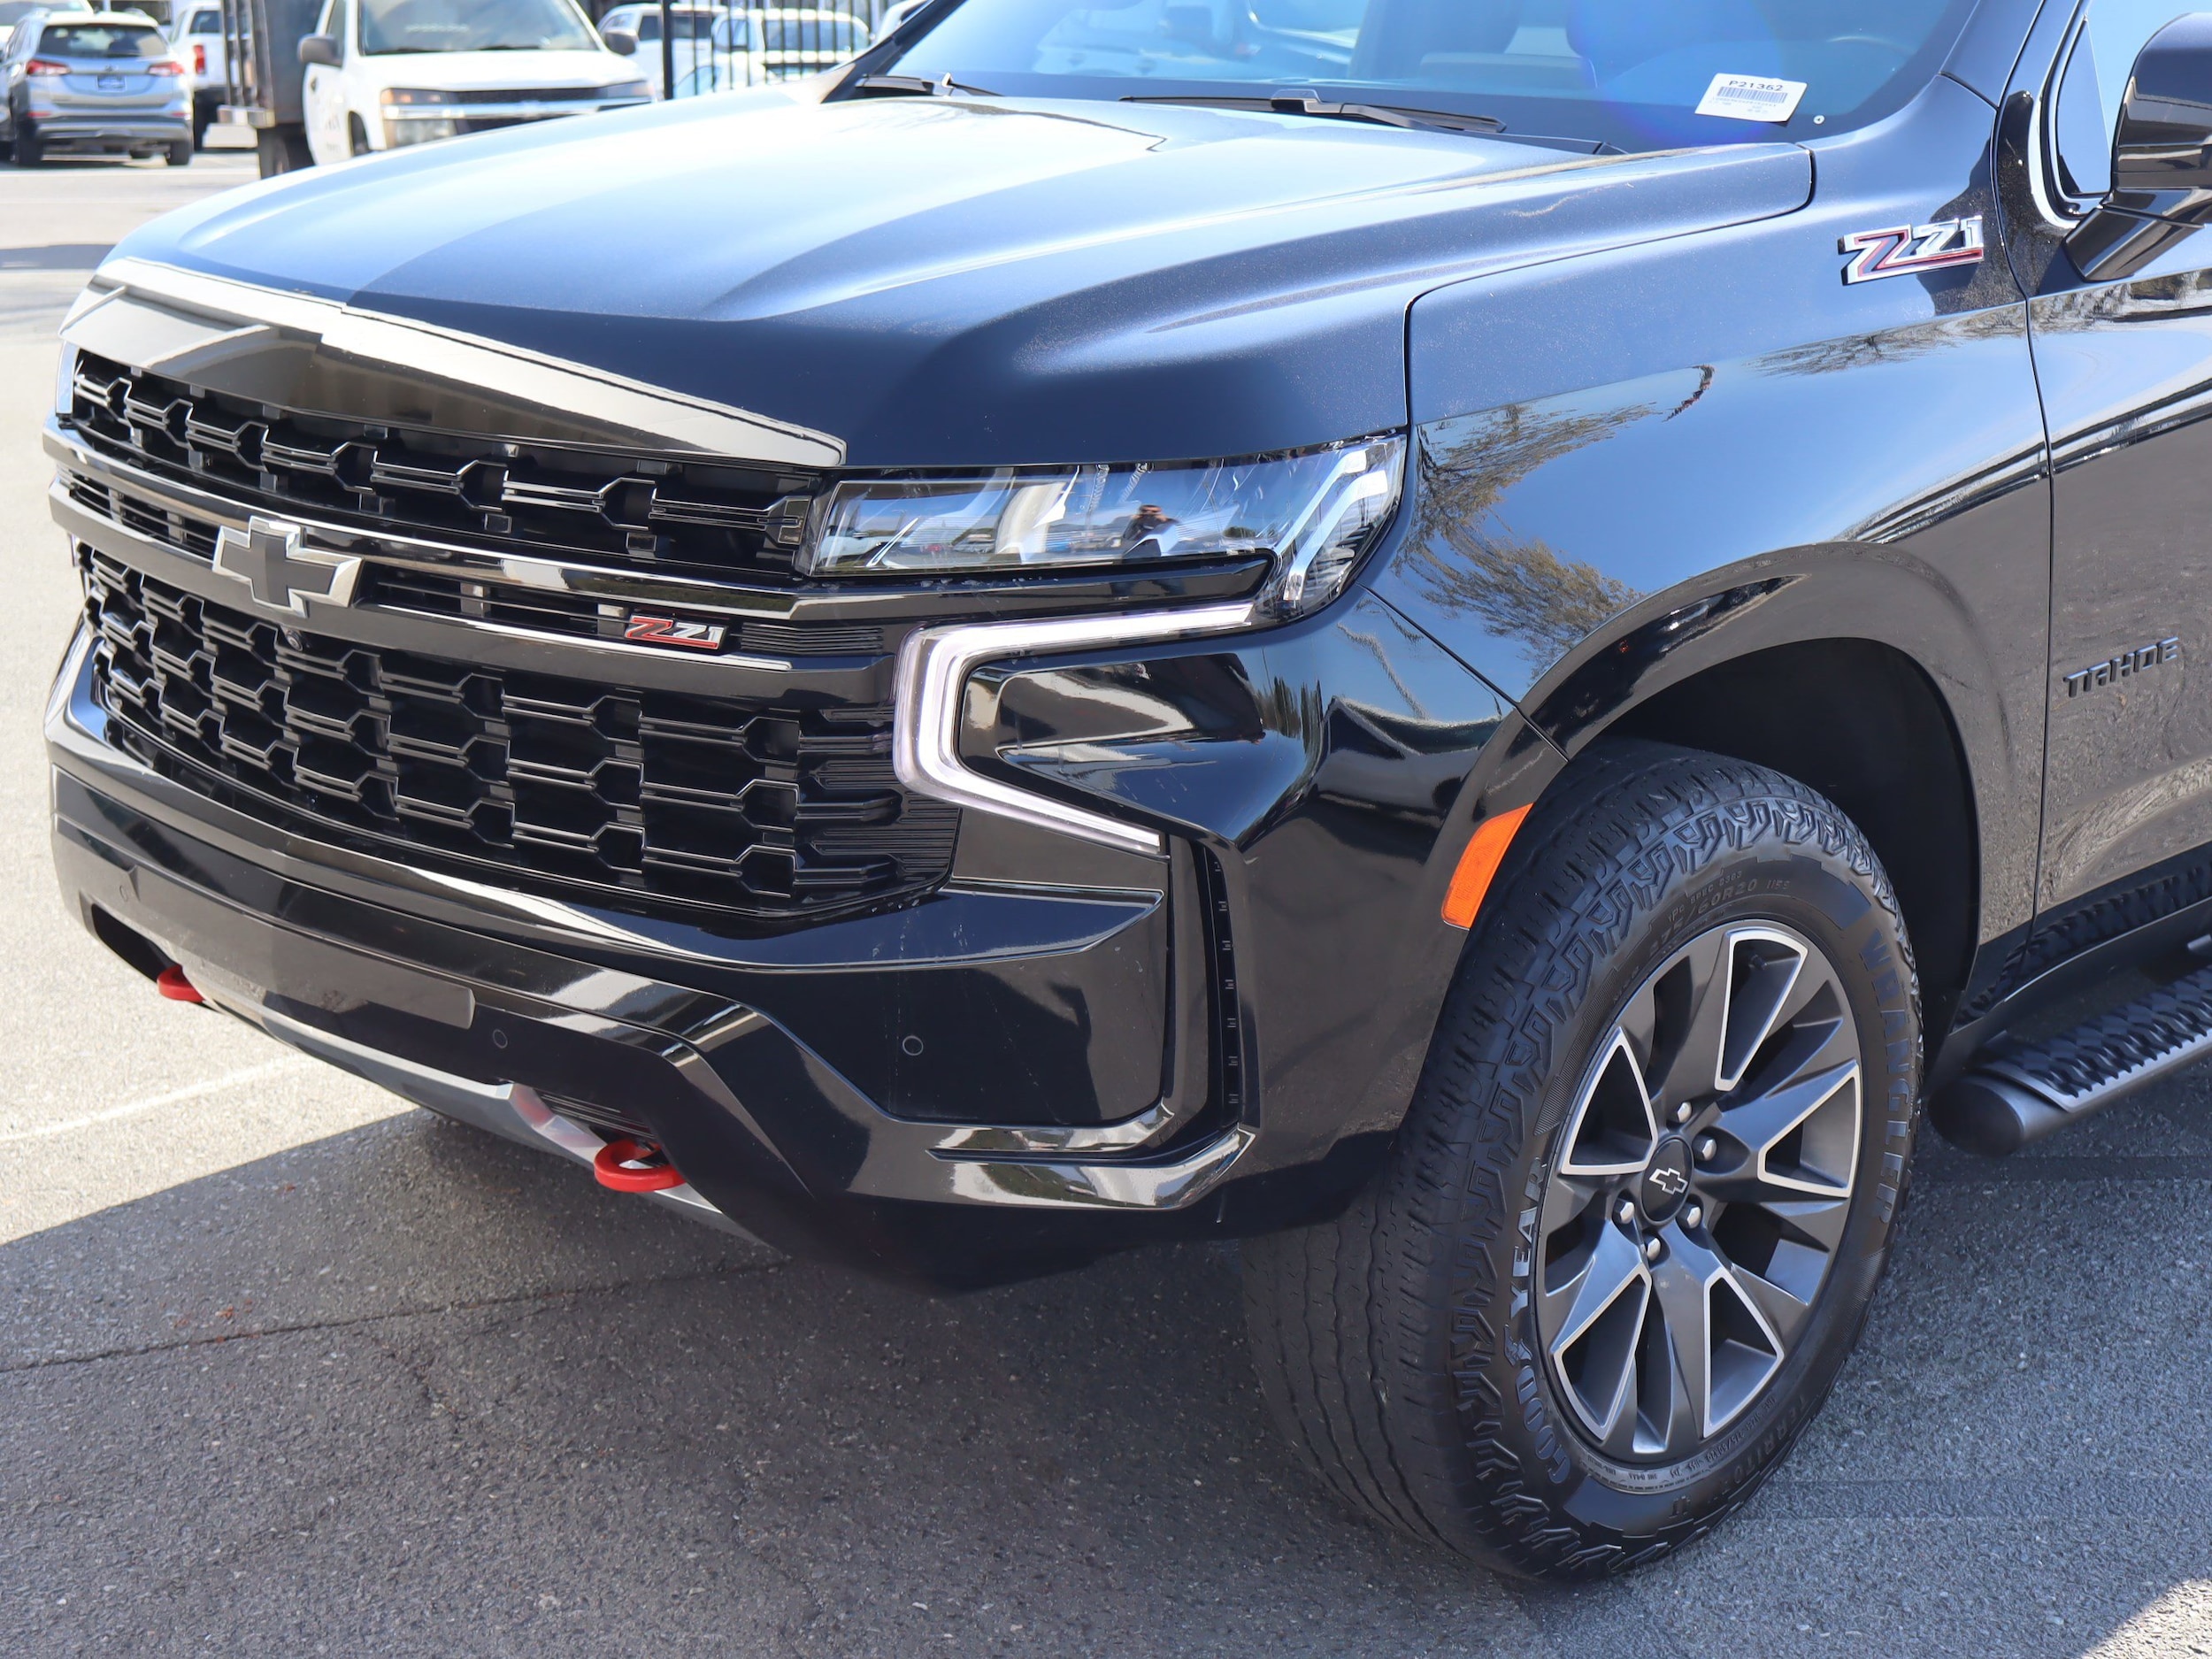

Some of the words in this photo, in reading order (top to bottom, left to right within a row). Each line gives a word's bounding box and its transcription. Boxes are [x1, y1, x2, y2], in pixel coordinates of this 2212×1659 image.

[1728, 81, 1784, 91] P21362
[1838, 215, 1985, 286] Z71
[625, 615, 728, 650] Z71
[2062, 636, 2179, 698] TAHOE
[1859, 928, 1911, 1225] WRANGLER
